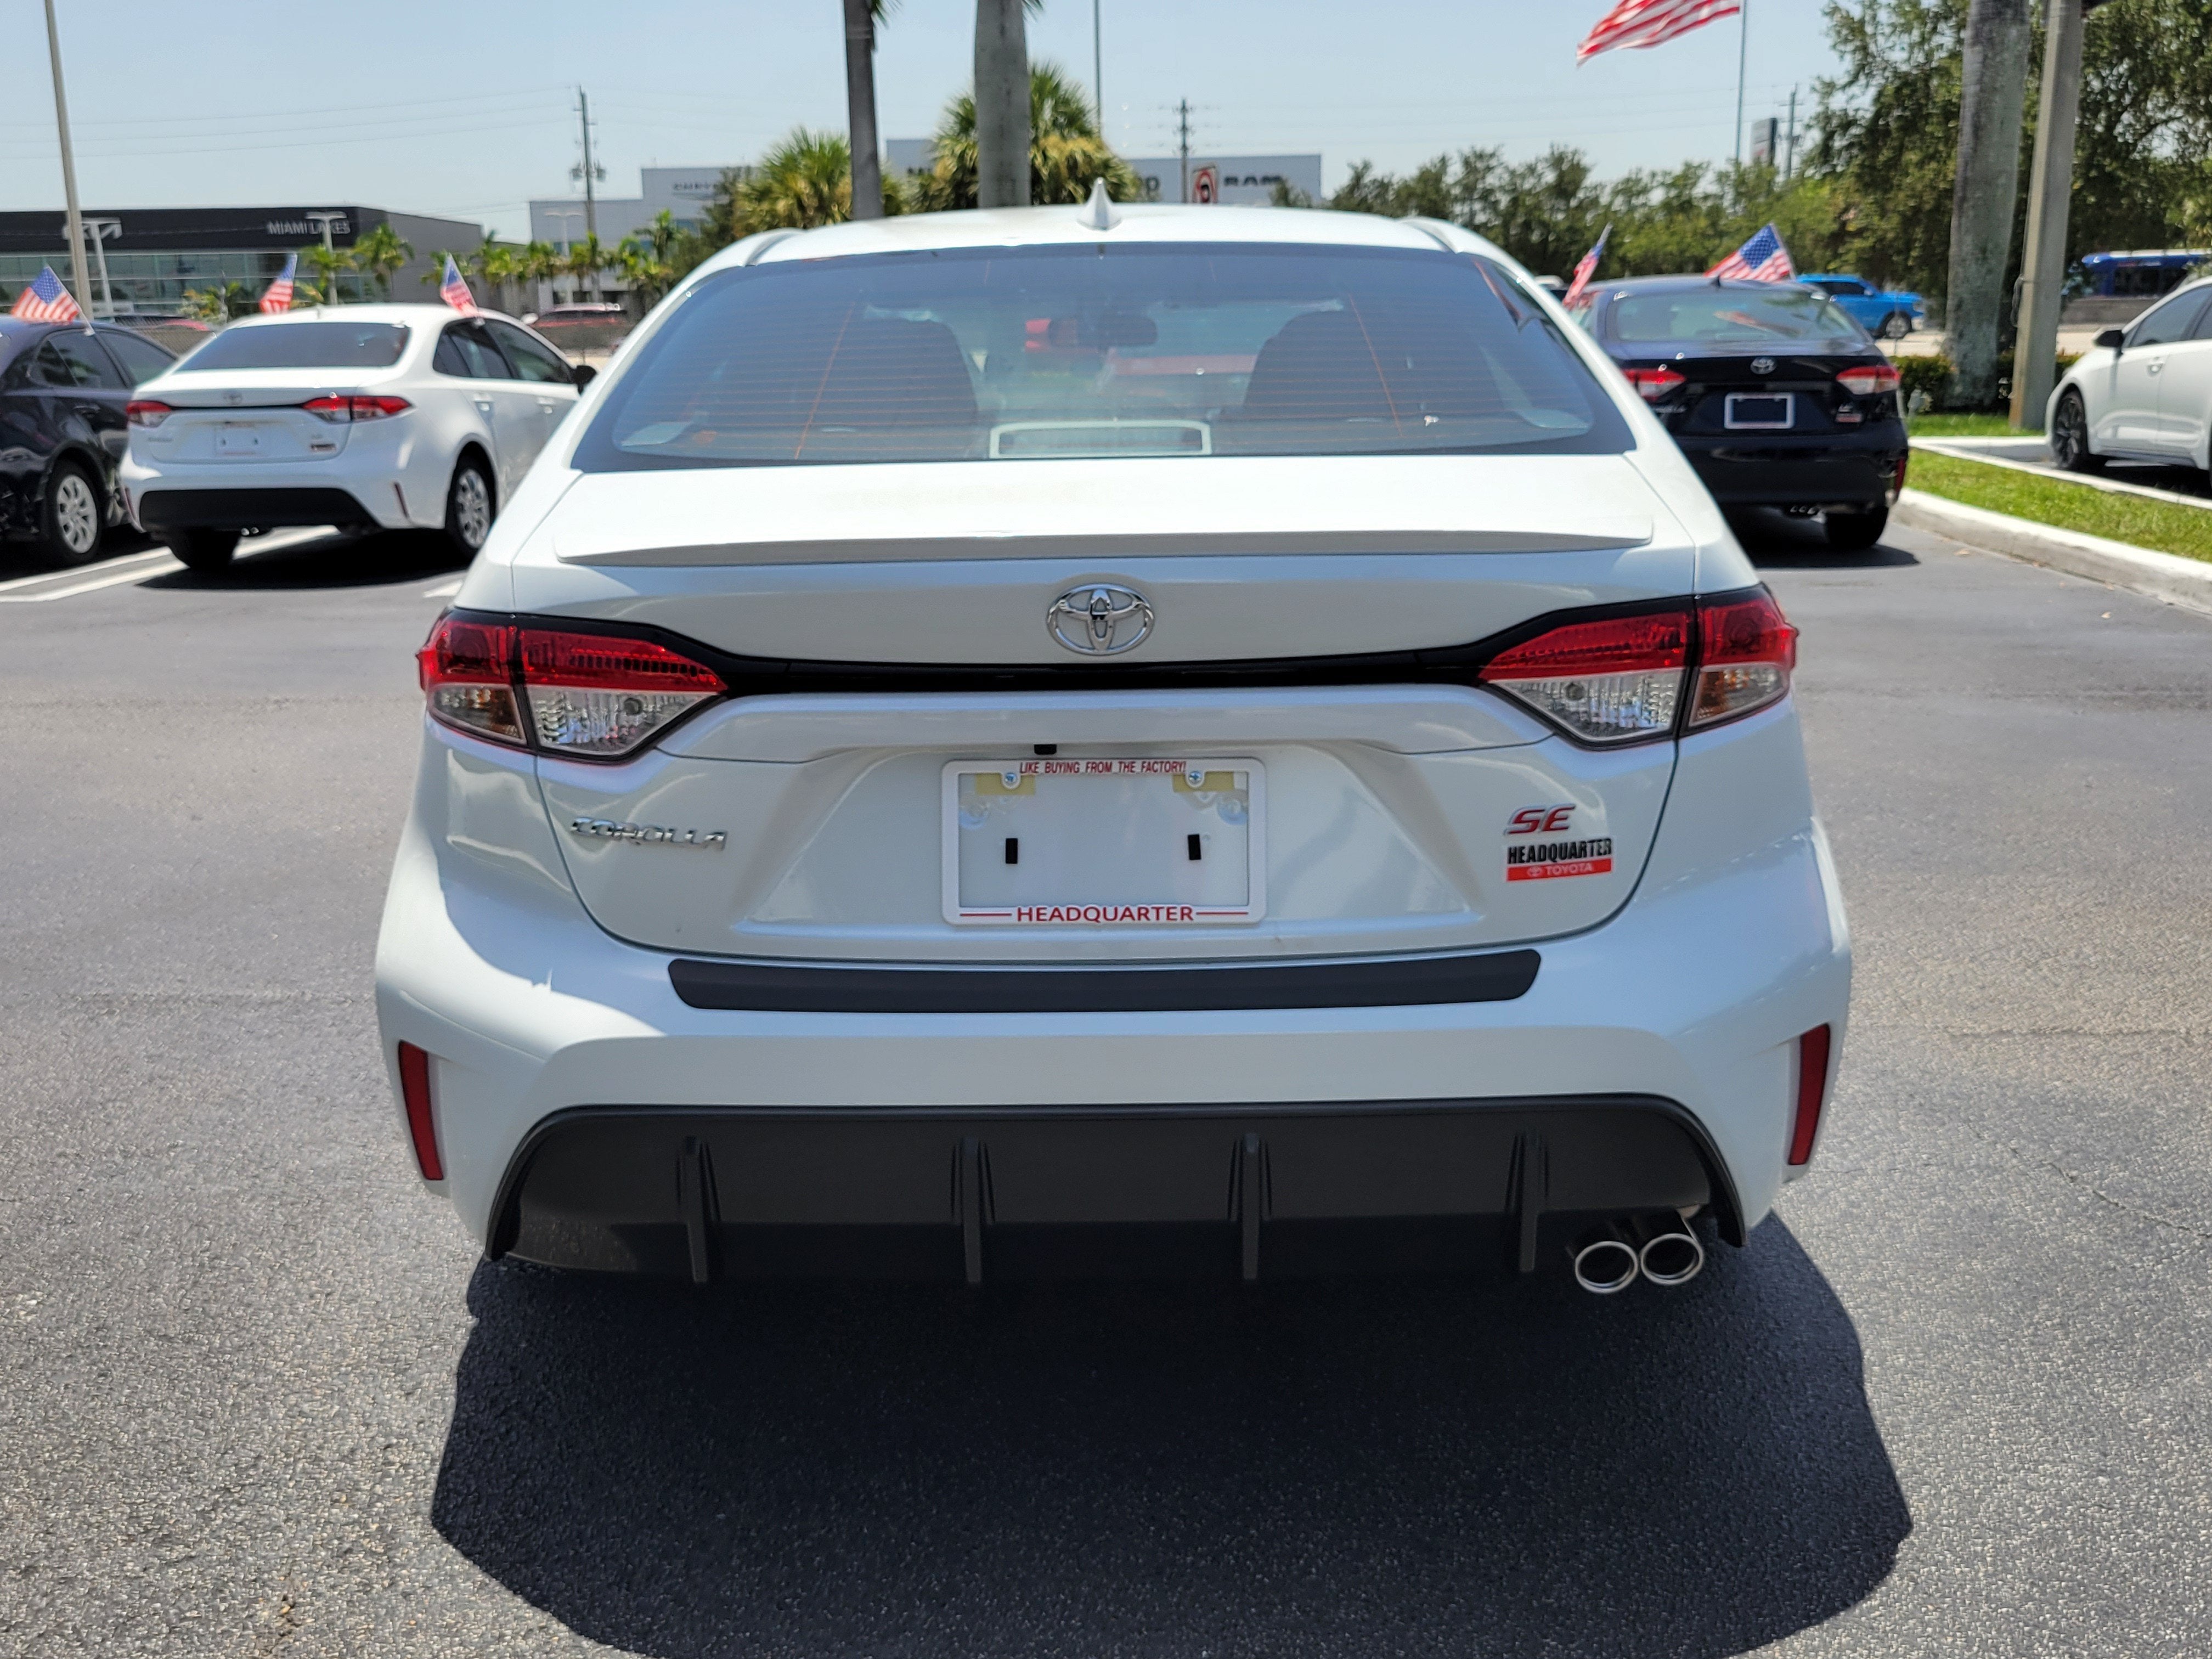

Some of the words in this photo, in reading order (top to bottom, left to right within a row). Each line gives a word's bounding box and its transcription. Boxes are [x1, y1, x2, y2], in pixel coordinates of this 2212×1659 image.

[267, 221, 307, 234] MIAMI
[1019, 761, 1040, 774] LIKE
[1045, 761, 1080, 774] BUYING
[1085, 761, 1113, 774] FROM
[1118, 761, 1136, 774] THE
[1141, 760, 1187, 774] FACTORY!
[1504, 803, 1576, 835] SE
[571, 817, 727, 851] COROLLA
[1507, 838, 1612, 865] HEADQUARTER
[1545, 862, 1593, 876] TOYOTA
[1017, 906, 1194, 924] HEADQUARTER
